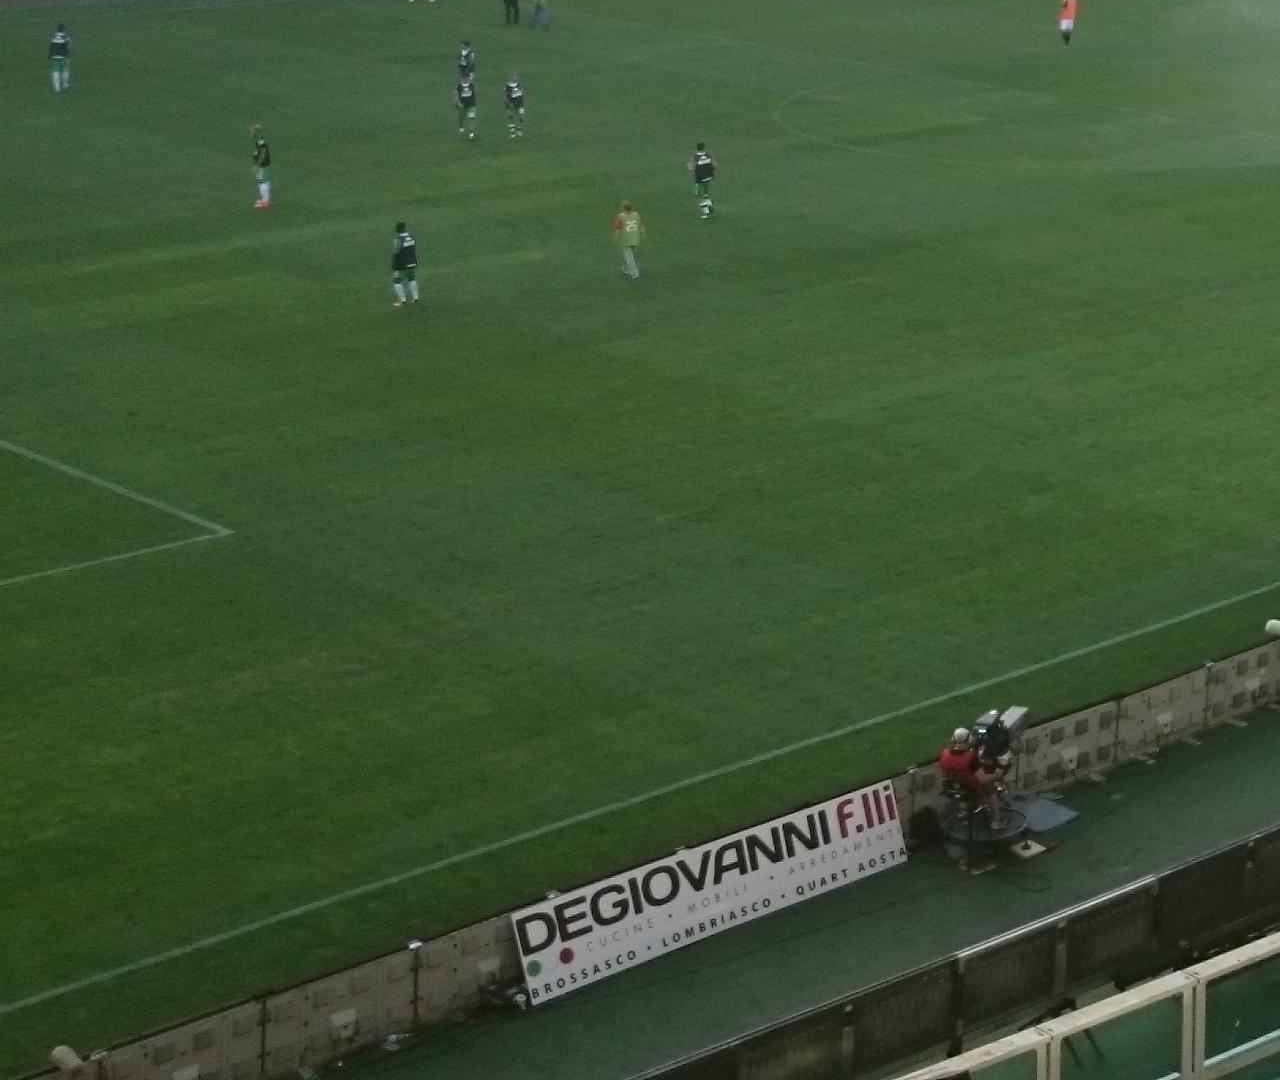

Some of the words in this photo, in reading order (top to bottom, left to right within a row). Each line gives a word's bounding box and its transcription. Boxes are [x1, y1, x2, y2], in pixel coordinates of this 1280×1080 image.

[516, 809, 832, 957] DEGIOVANNI
[837, 785, 897, 839] F.lli
[531, 950, 637, 1000] BROSSASCO
[662, 898, 772, 948] LOMBRIASCO
[796, 868, 849, 896] QUART
[858, 846, 908, 874] AOSTA
[586, 918, 654, 952] CUCINE
[688, 884, 749, 914] MOBILI
